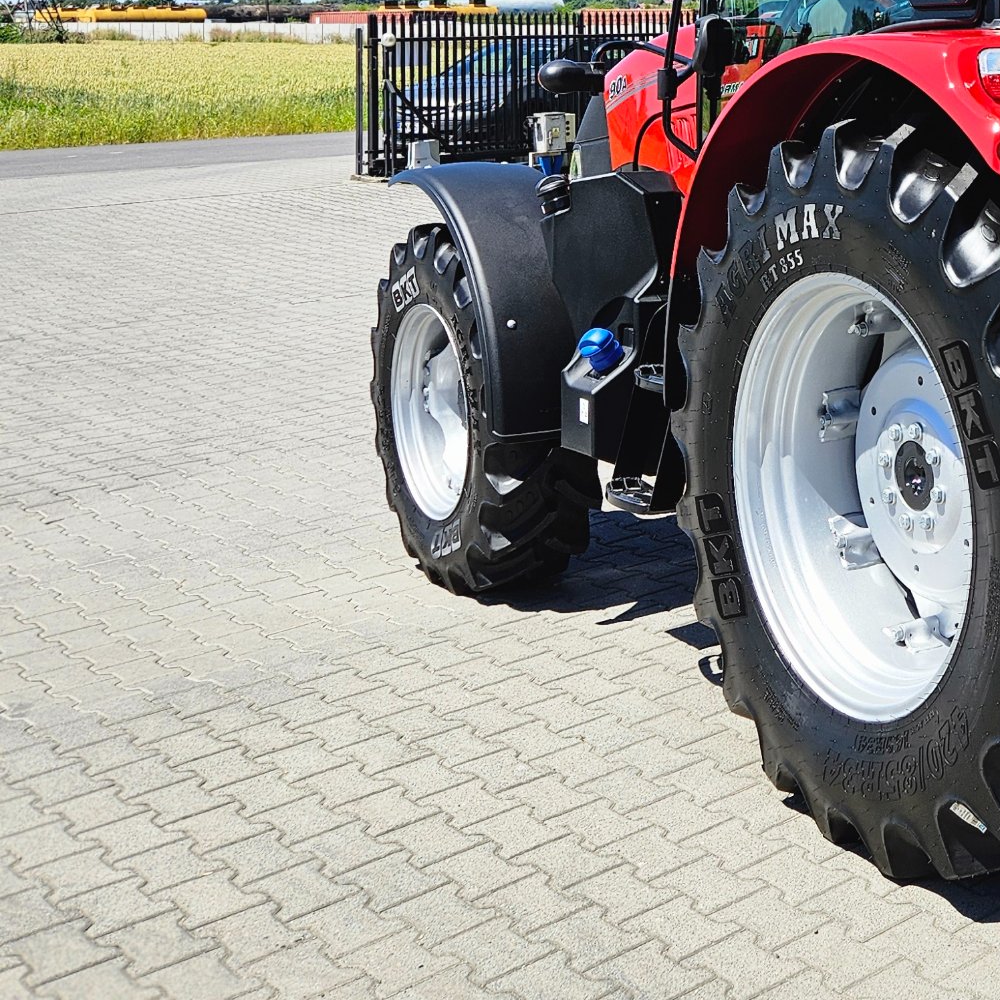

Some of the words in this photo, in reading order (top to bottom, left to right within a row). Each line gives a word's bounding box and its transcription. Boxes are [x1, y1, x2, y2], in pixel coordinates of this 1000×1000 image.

[392, 270, 418, 310] BKT
[758, 263, 779, 293] RT
[780, 249, 804, 275] 855
[697, 497, 743, 618] BKT
